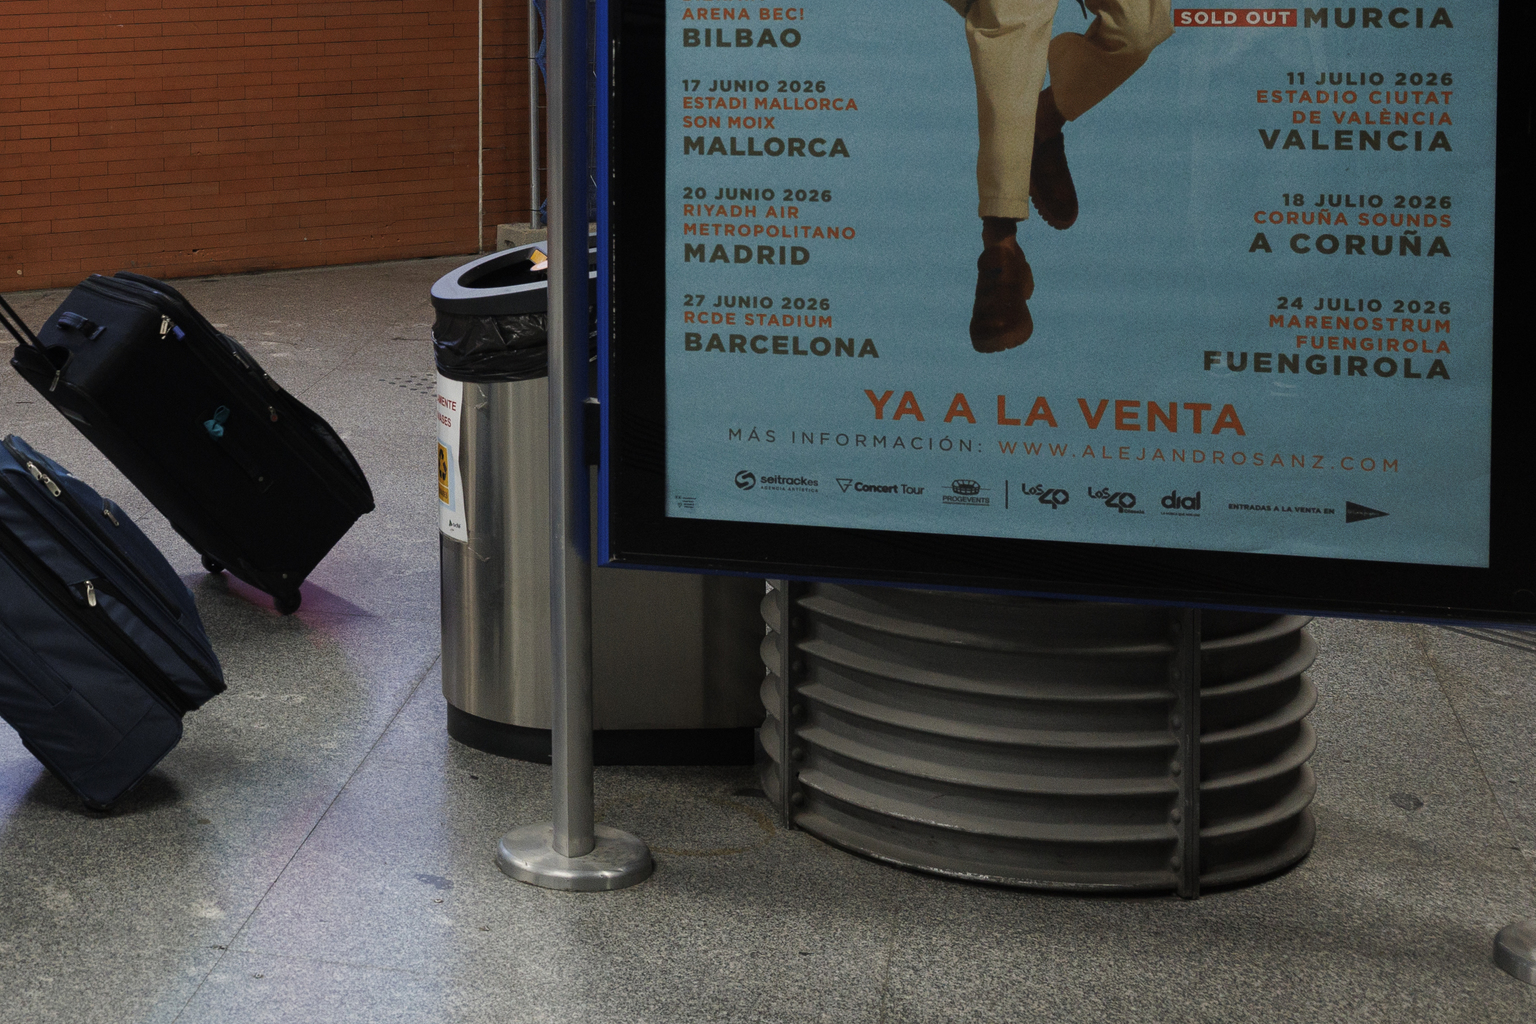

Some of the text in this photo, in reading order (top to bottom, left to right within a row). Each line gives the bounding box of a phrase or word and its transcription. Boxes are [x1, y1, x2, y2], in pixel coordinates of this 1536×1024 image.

[683, 8, 804, 20] ARENA BEC!
[1181, 7, 1453, 28] SOLD OUT MURCIA
[683, 28, 801, 48] BILBAO
[684, 136, 850, 157] MALLORCA
[1259, 129, 1452, 151] VALENCIA
[684, 204, 798, 218] RIYADH AIR
[1254, 209, 1451, 228] CORUÑA SOUNDS
[684, 223, 855, 240] METROPOLITANO
[1249, 230, 1451, 257] A CORUÑA
[685, 243, 810, 265] MADRID
[684, 311, 832, 327] RCDE STADIUM
[1269, 315, 1450, 333] MARENOSTRUM
[685, 333, 879, 358] BARCELONA
[1297, 335, 1450, 354] FUENGIROLA
[1204, 351, 1450, 380] FUENGIROLA
[865, 390, 1245, 436] YA A LA VENTA
[729, 426, 1398, 473] MÁS INFORMACIÓN: WWW.ALEJANDROSANZ.COM
[854, 481, 924, 495] Concert Tour
